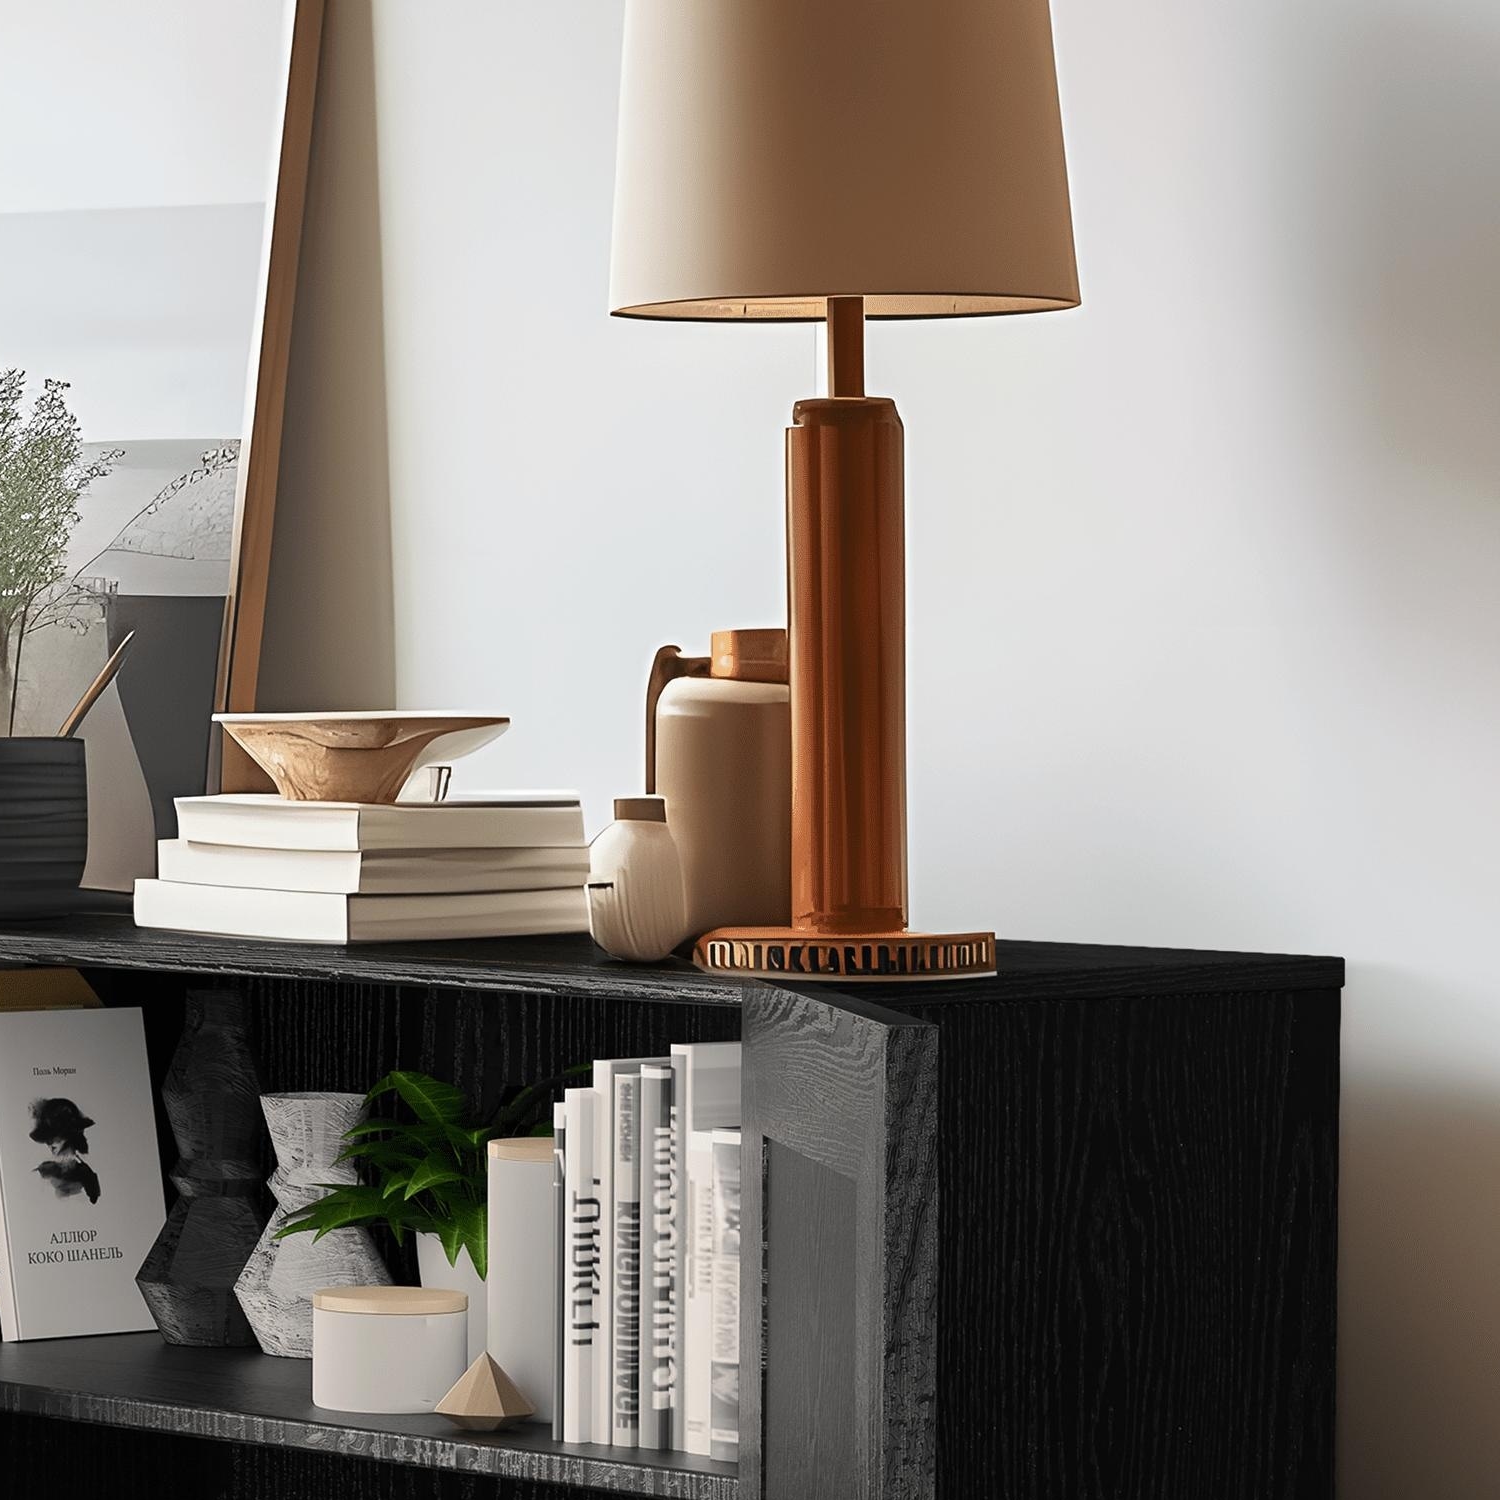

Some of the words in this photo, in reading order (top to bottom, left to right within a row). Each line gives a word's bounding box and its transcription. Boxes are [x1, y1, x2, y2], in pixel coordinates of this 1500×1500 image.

[32, 1067, 51, 1076] Поль
[52, 1066, 77, 1077] Моран
[49, 1230, 98, 1245] АЛЛЮР
[27, 1250, 64, 1264] КОКО
[65, 1246, 124, 1261] ШАНЕЛЬ
